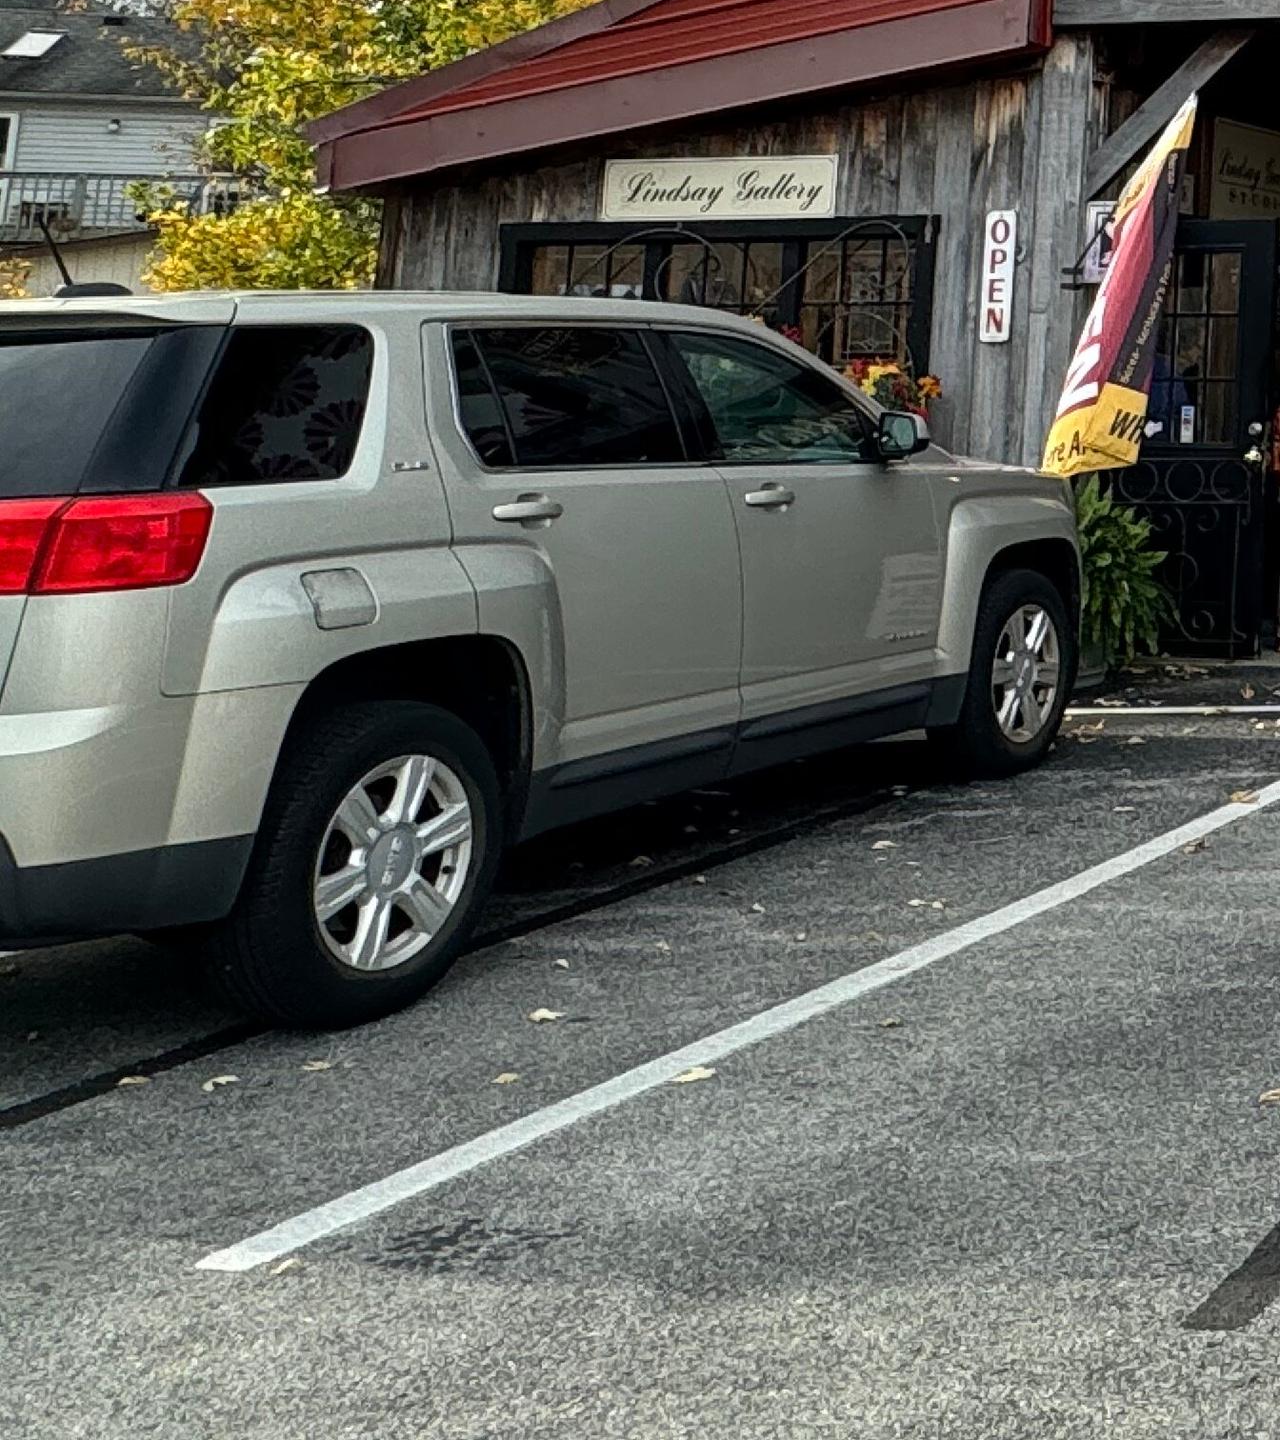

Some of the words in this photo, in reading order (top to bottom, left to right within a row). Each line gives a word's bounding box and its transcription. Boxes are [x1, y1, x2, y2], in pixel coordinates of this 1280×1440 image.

[621, 171, 724, 213] Lindsay
[732, 169, 824, 211] Gallery
[985, 218, 1010, 334] OPEN
